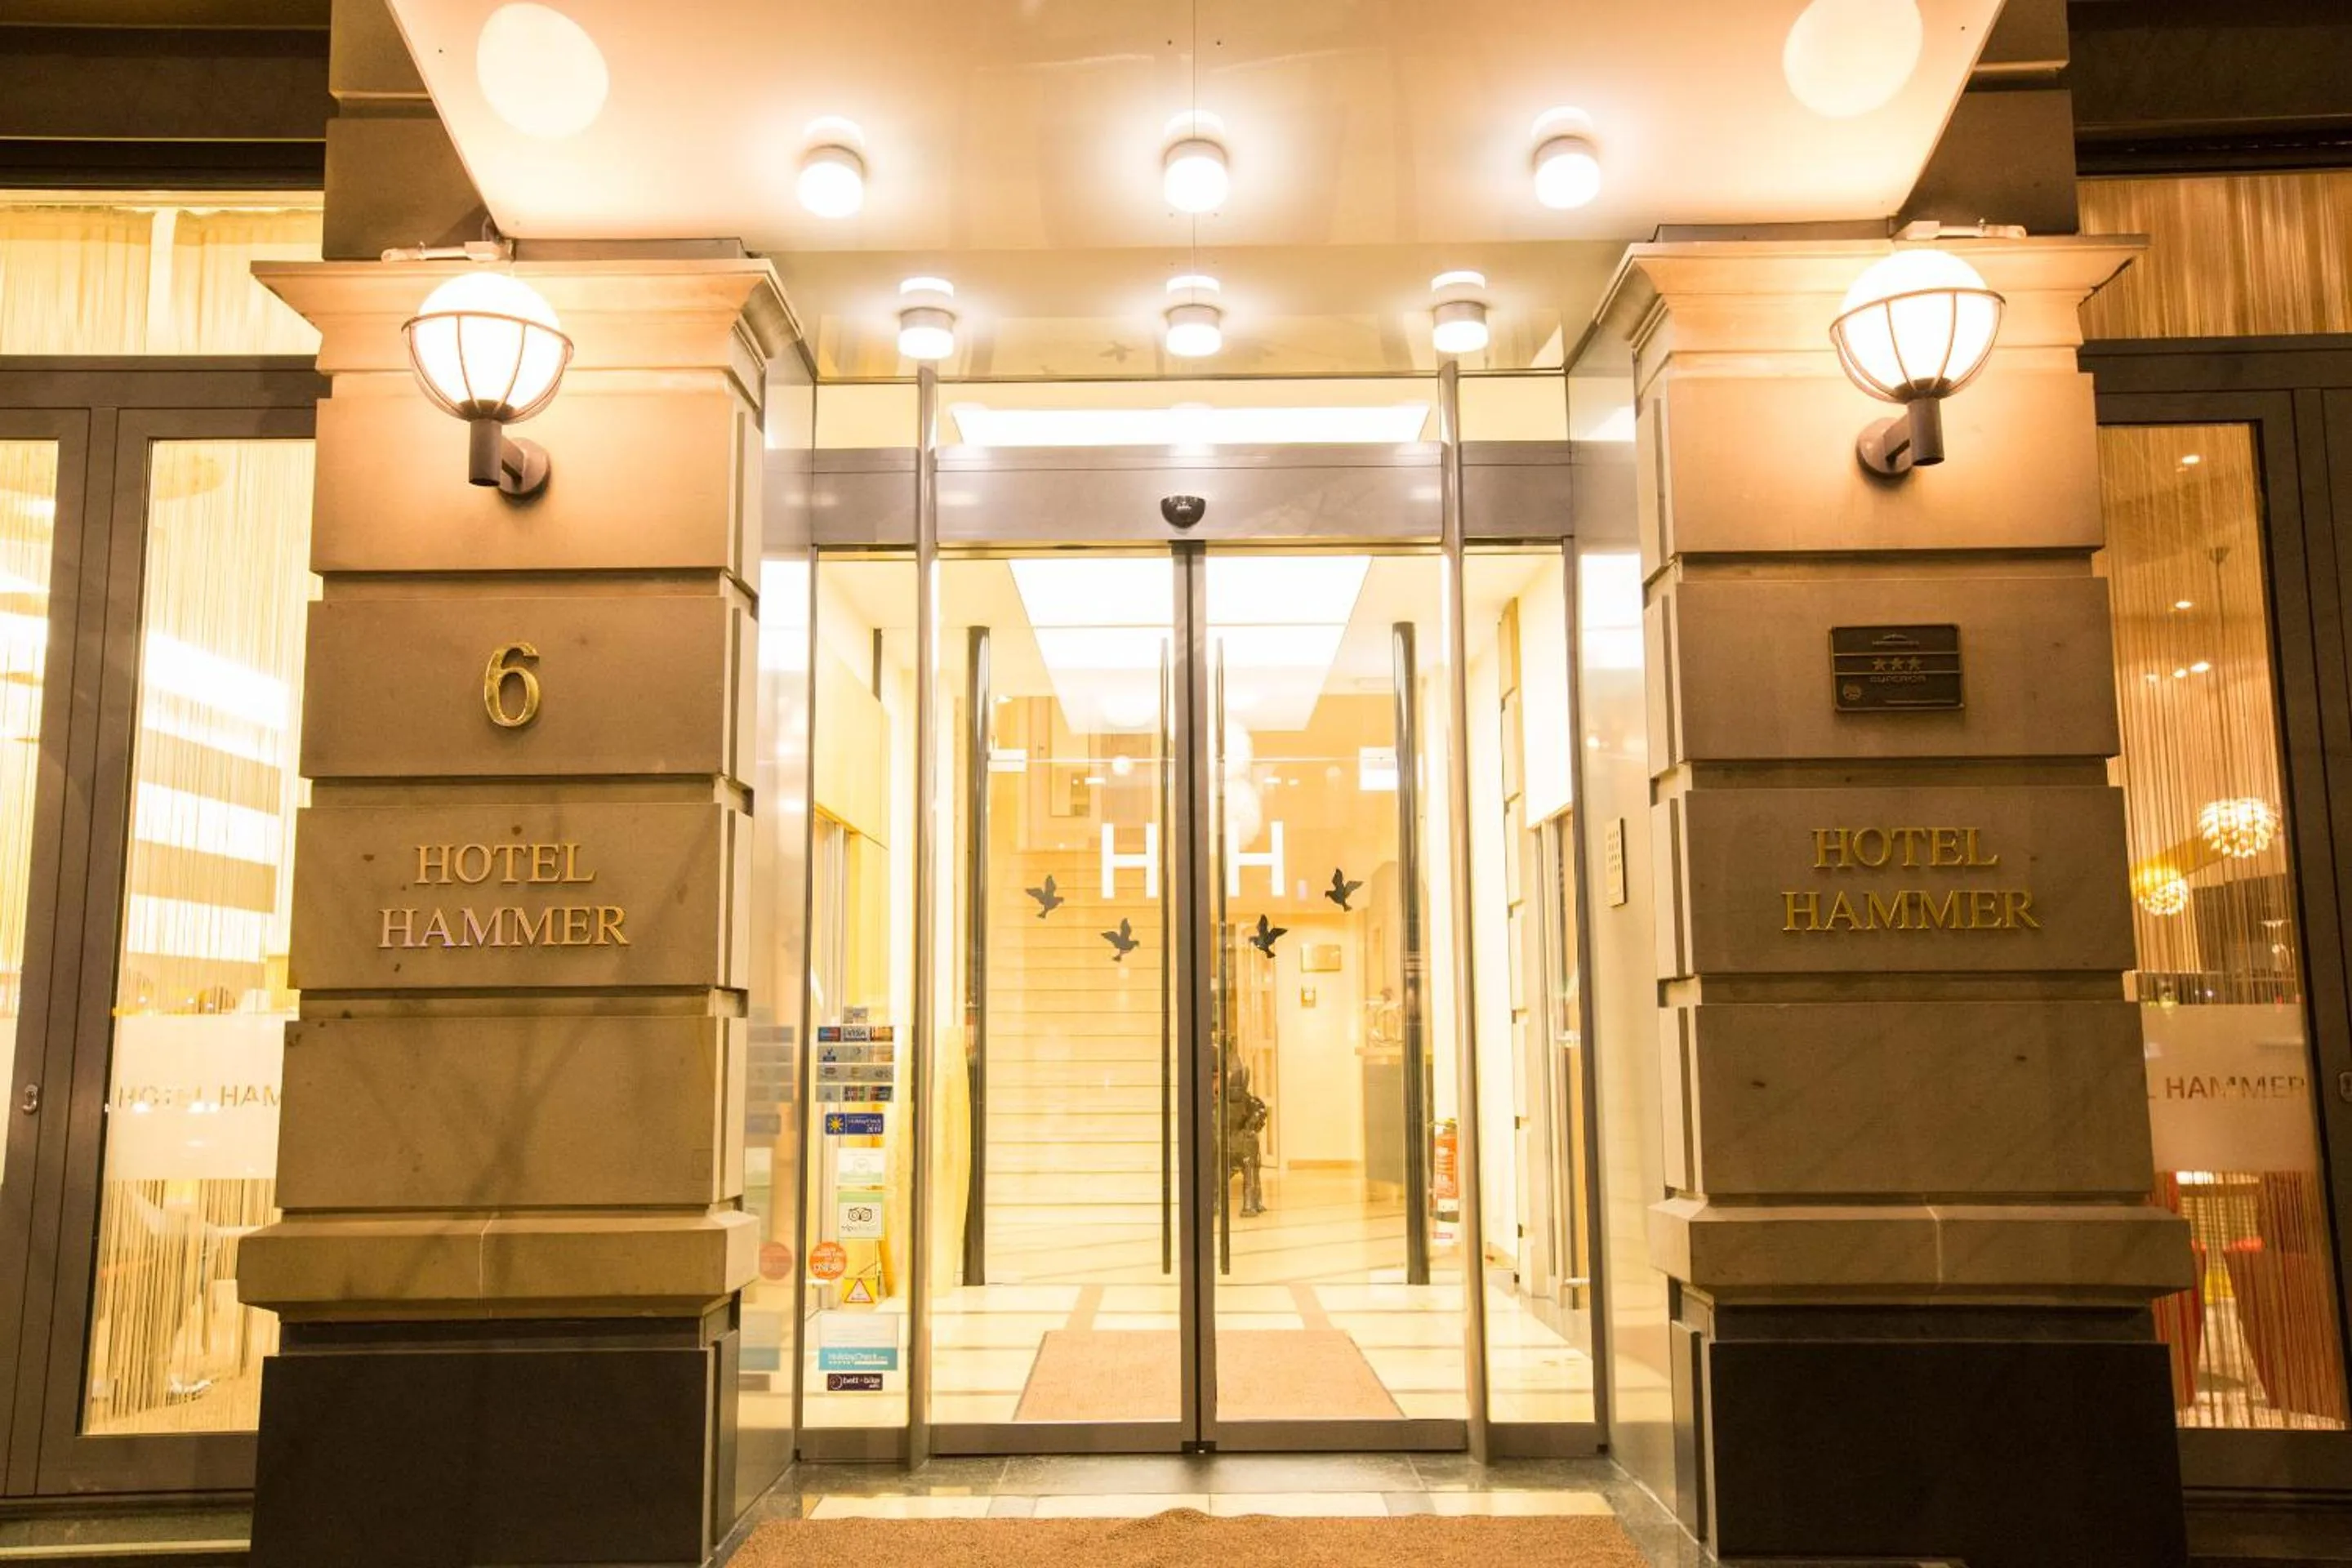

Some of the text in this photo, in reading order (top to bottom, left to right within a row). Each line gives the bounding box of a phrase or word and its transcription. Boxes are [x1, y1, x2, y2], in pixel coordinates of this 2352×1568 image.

[483, 642, 541, 728] 6
[413, 842, 597, 886] HOTEL
[1101, 820, 1286, 899] H H
[1811, 826, 1999, 871] HOTEL
[377, 903, 630, 950] HAMMER
[1780, 889, 2042, 933] HAMMER
